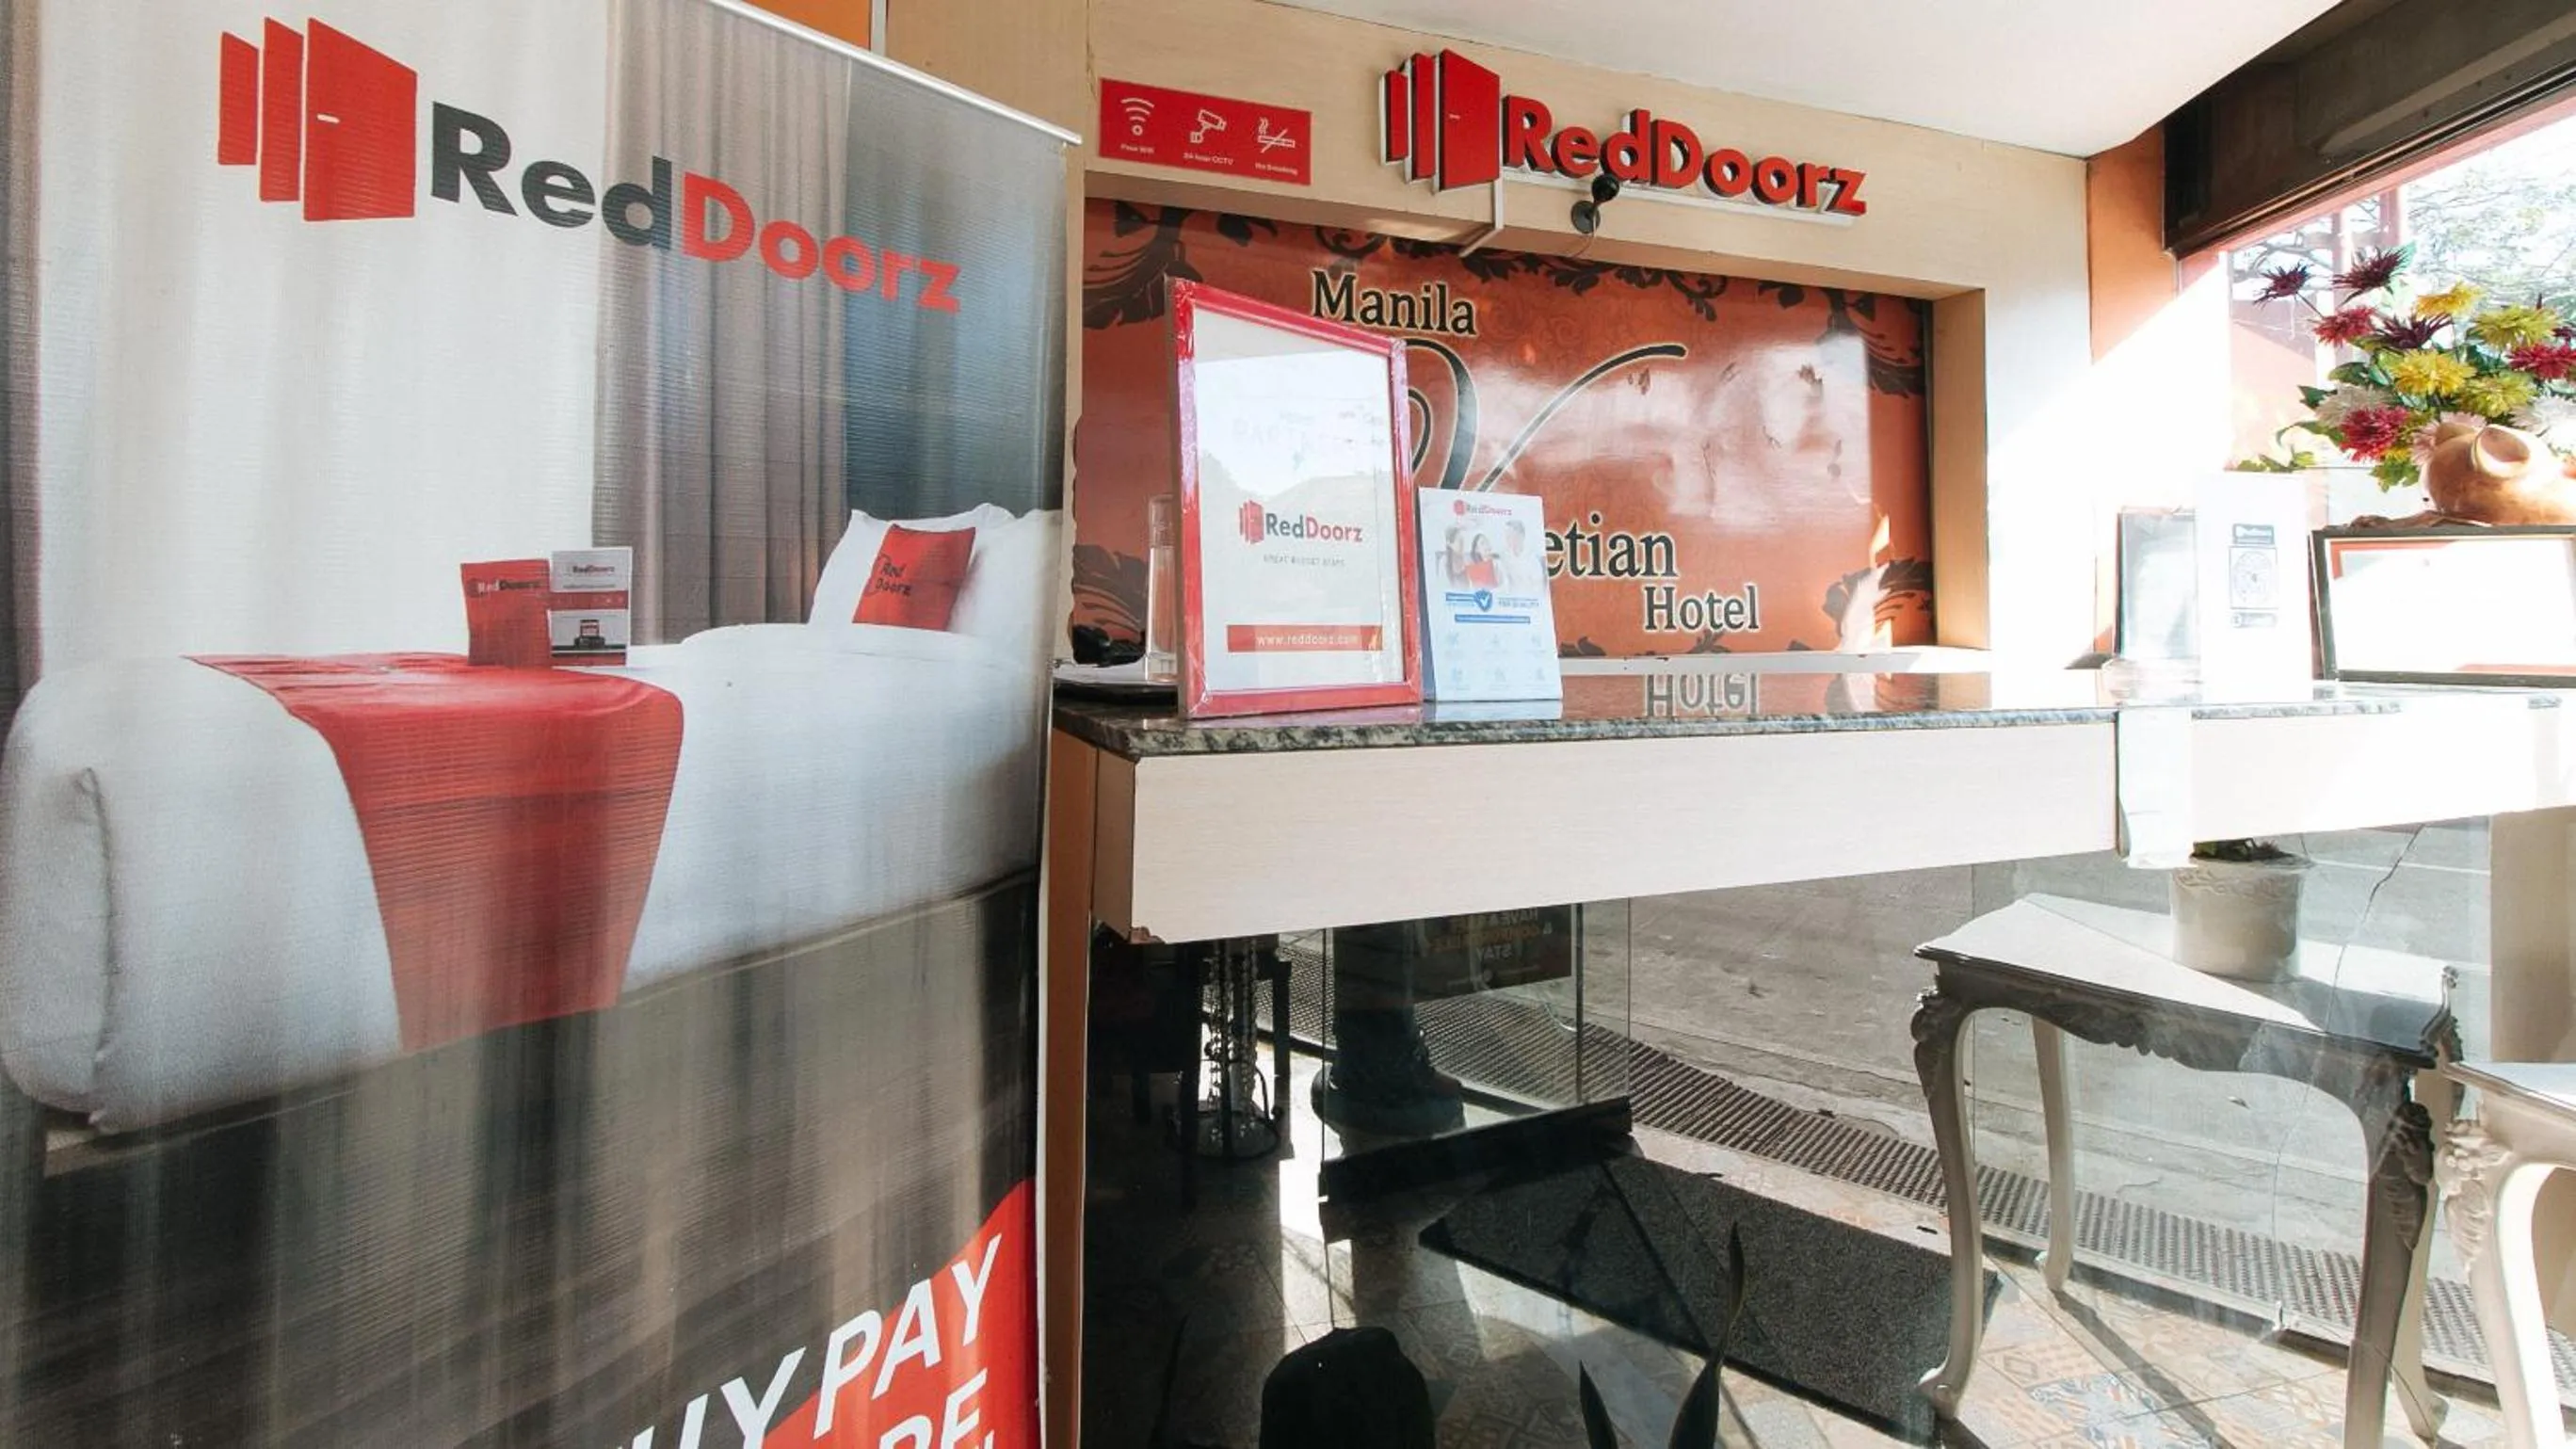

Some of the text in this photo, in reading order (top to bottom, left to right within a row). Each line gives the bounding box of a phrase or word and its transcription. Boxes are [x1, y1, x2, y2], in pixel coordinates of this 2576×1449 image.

[1502, 94, 1868, 217] RedDoorz
[431, 100, 961, 313] RedDoorz
[1312, 268, 1478, 336] Manila
[1265, 512, 1363, 542] RedDoorz
[1545, 512, 1679, 577] etian
[1645, 585, 1759, 631] Hotel
[813, 1233, 1002, 1440] PAY
